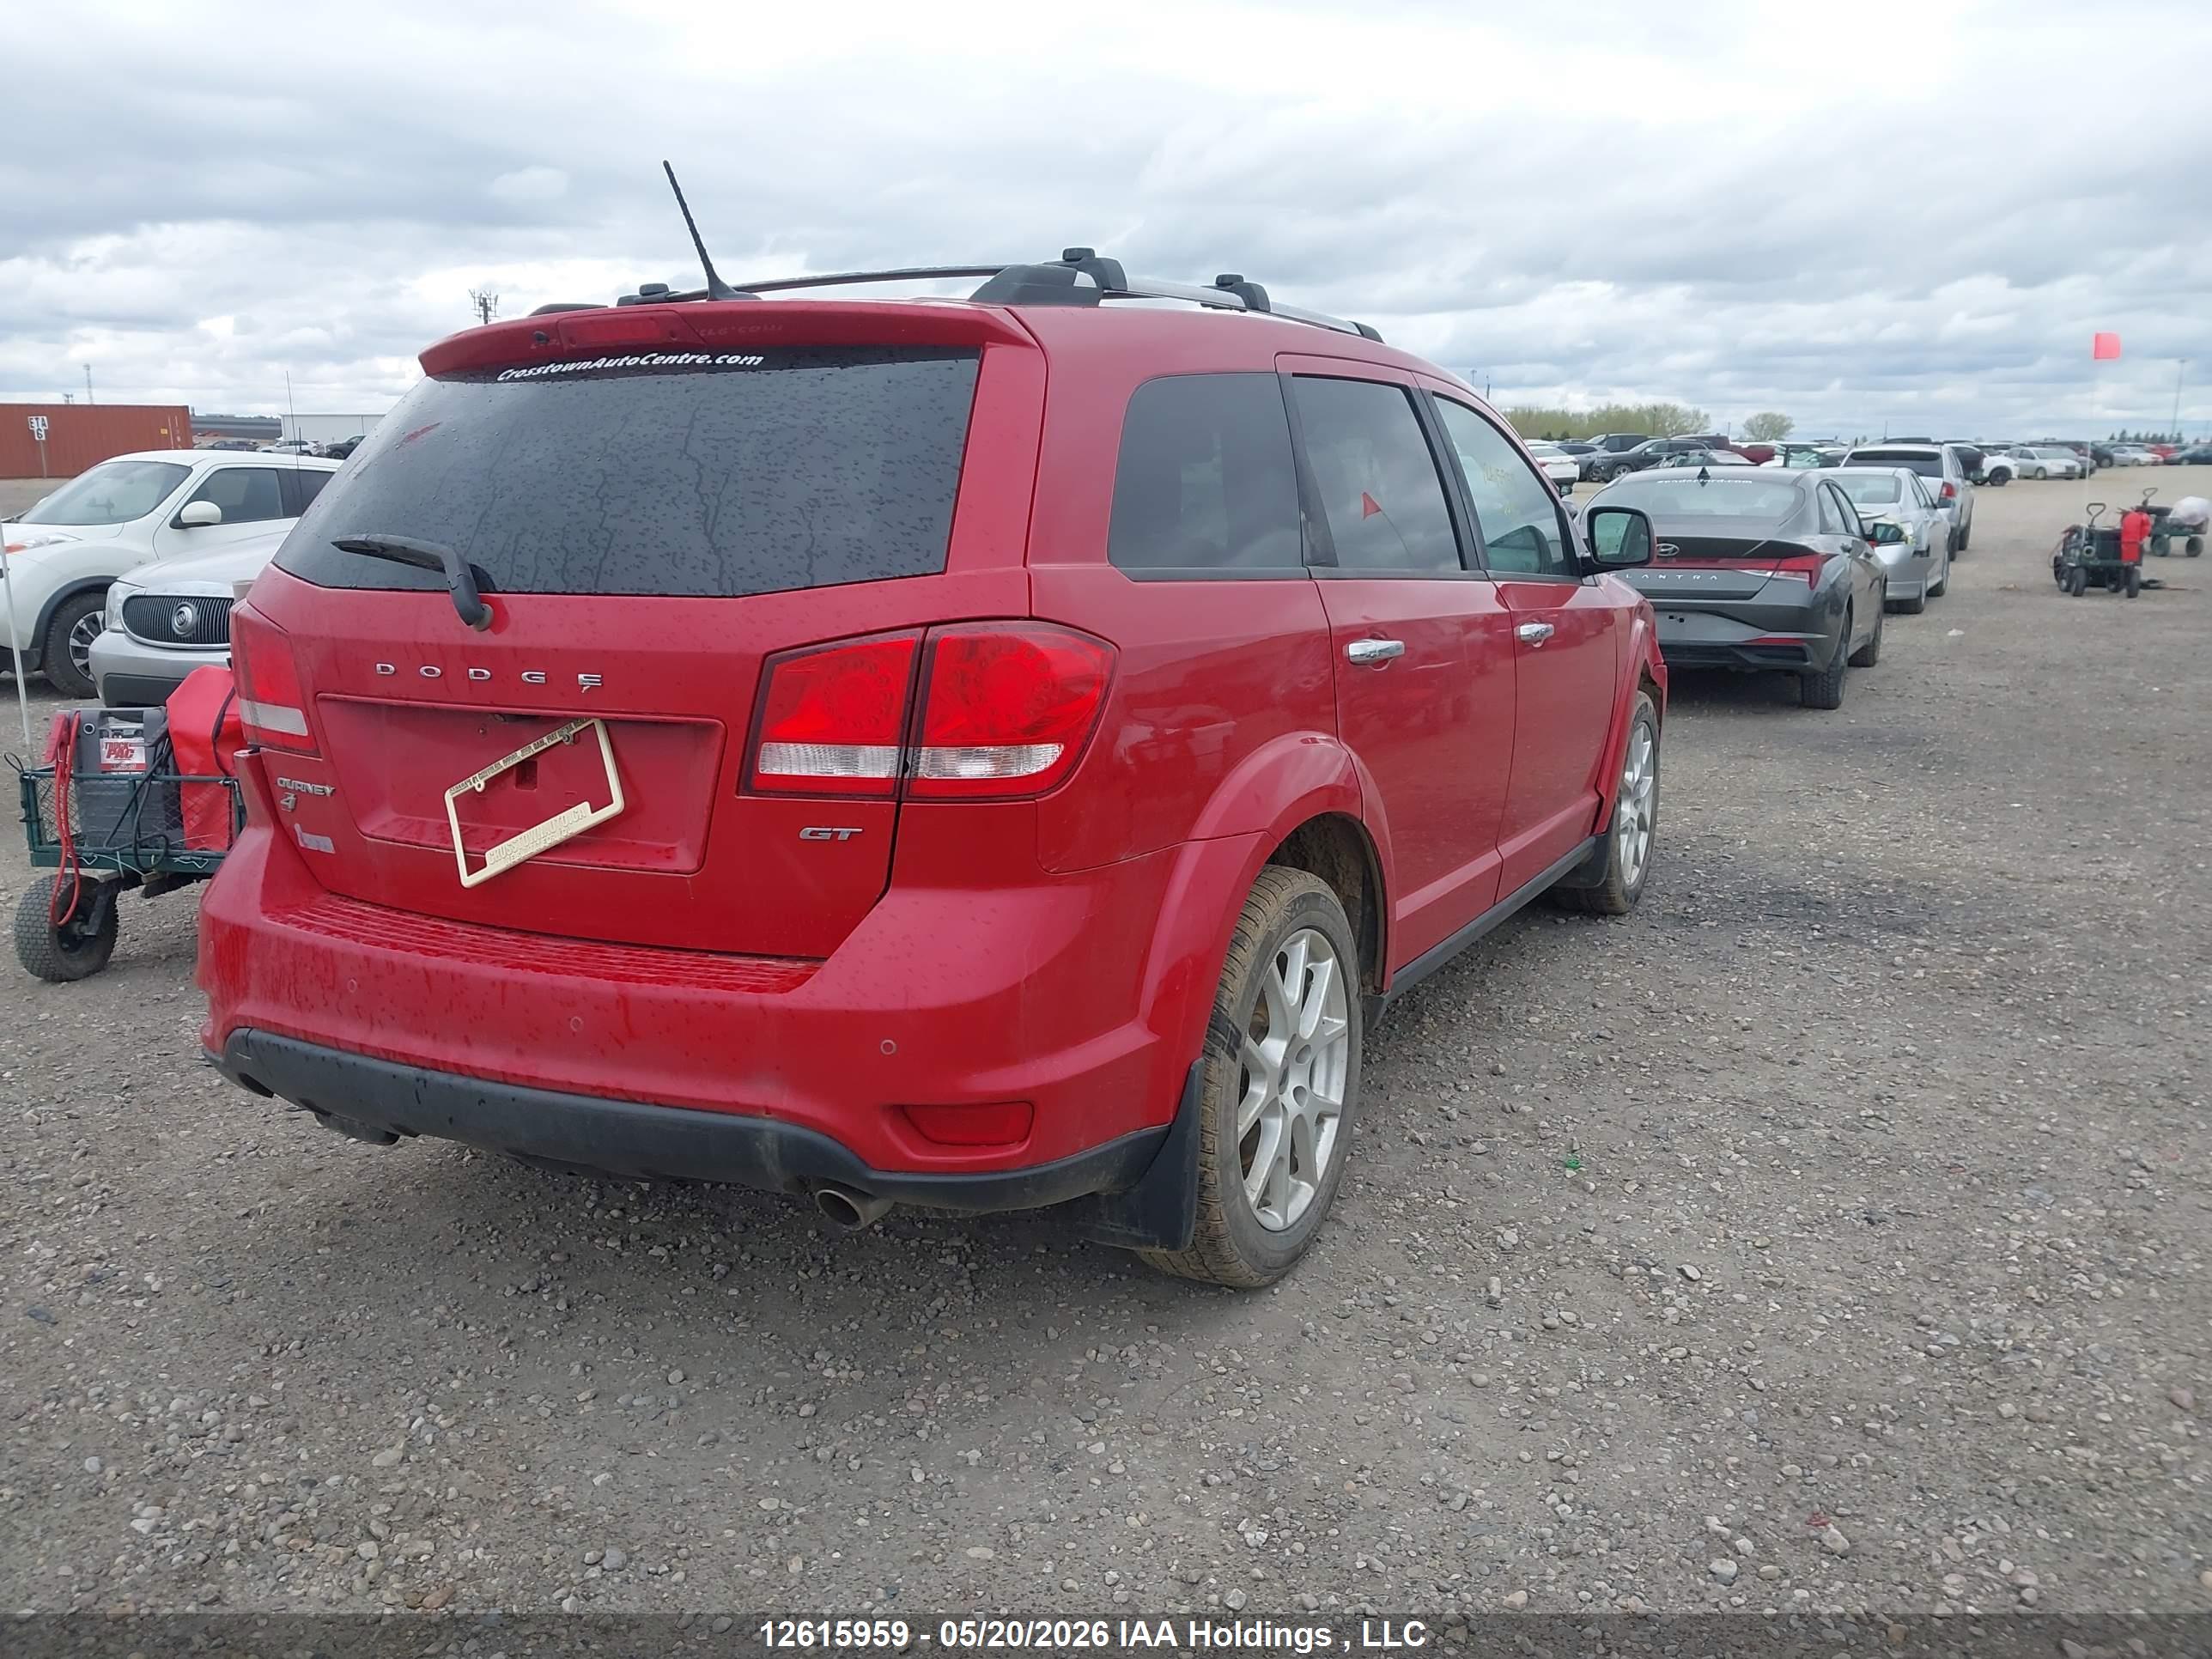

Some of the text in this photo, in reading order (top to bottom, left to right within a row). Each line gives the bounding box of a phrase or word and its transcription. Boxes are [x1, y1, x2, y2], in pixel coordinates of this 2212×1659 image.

[497, 353, 763, 380] CrosstownAutoCentre.com
[29, 417, 46, 428] ETA
[36, 428, 43, 439] 6
[376, 662, 602, 686] DODGE
[106, 749, 135, 759] PAC
[799, 827, 863, 841] GT
